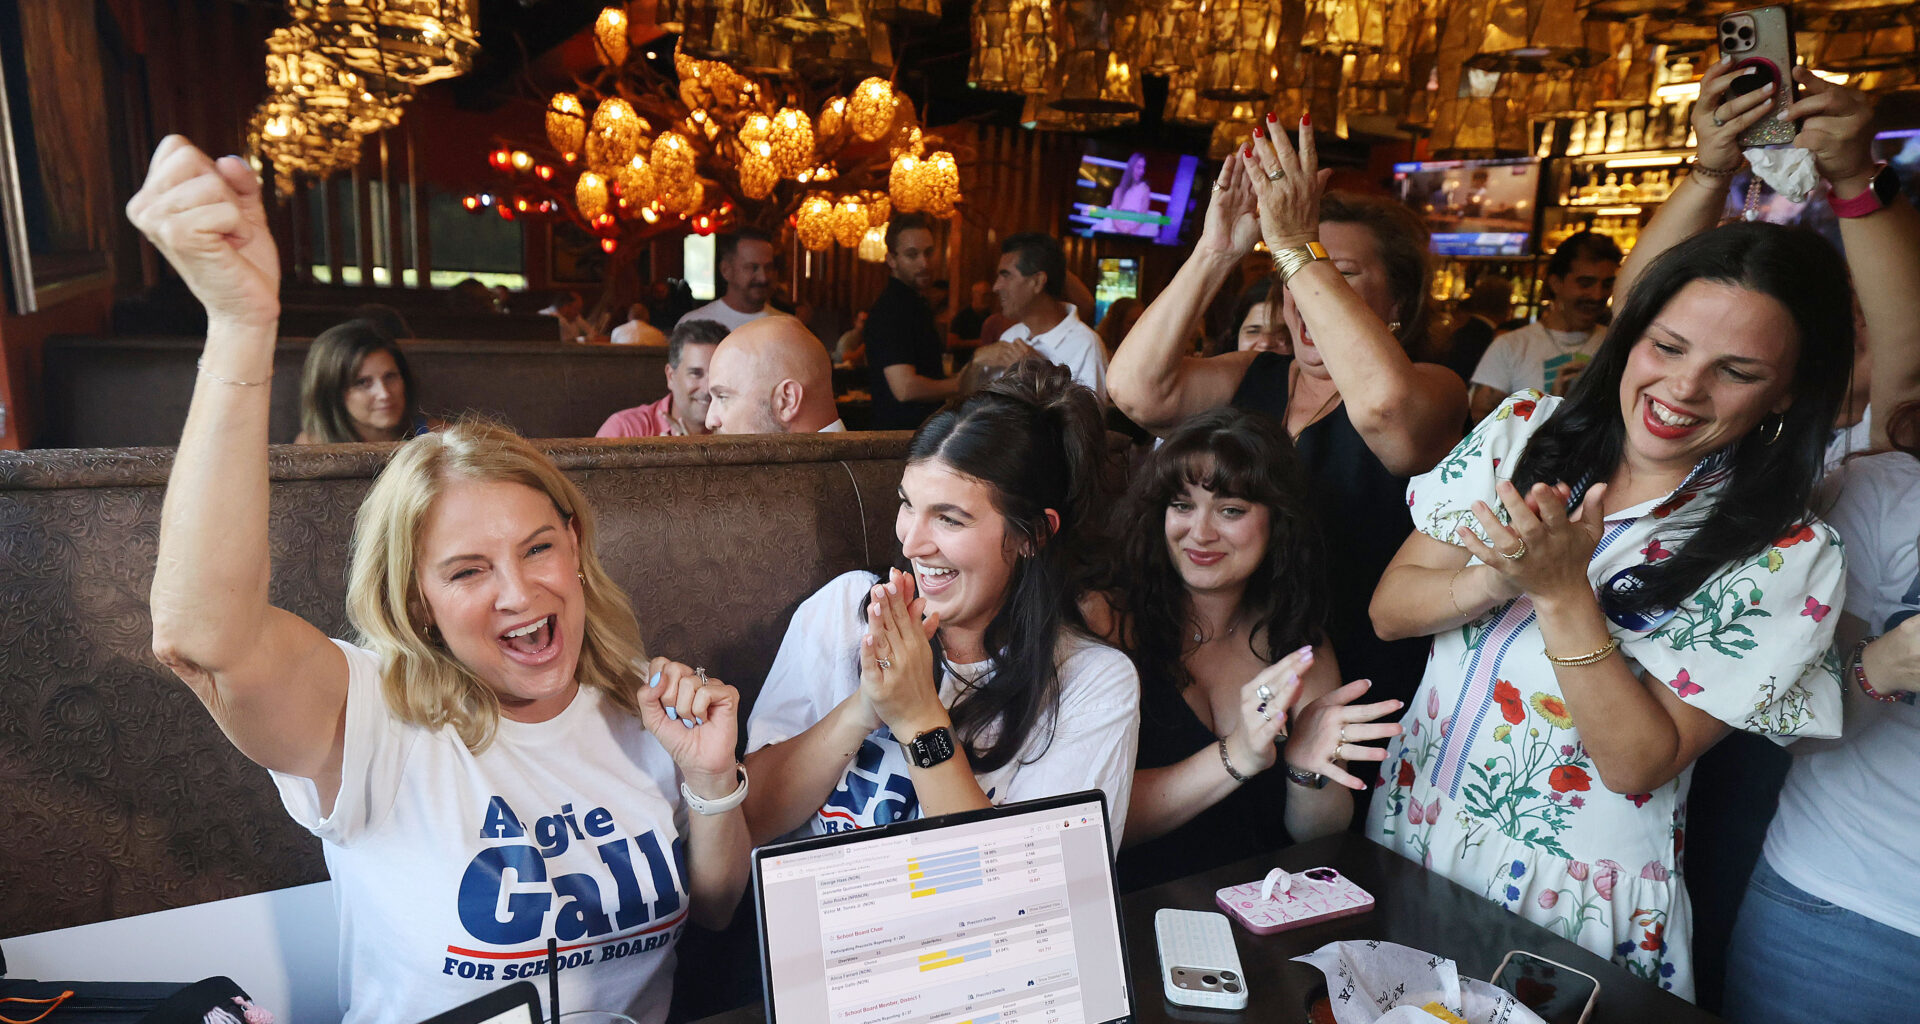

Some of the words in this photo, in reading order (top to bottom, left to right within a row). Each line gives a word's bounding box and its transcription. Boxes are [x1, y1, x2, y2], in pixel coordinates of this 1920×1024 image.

[480, 796, 615, 858] Agie
[443, 957, 495, 980] FOR
[603, 934, 671, 962] BOARD
[878, 1000, 899, 1008] Member,
[900, 995, 918, 1004] District
